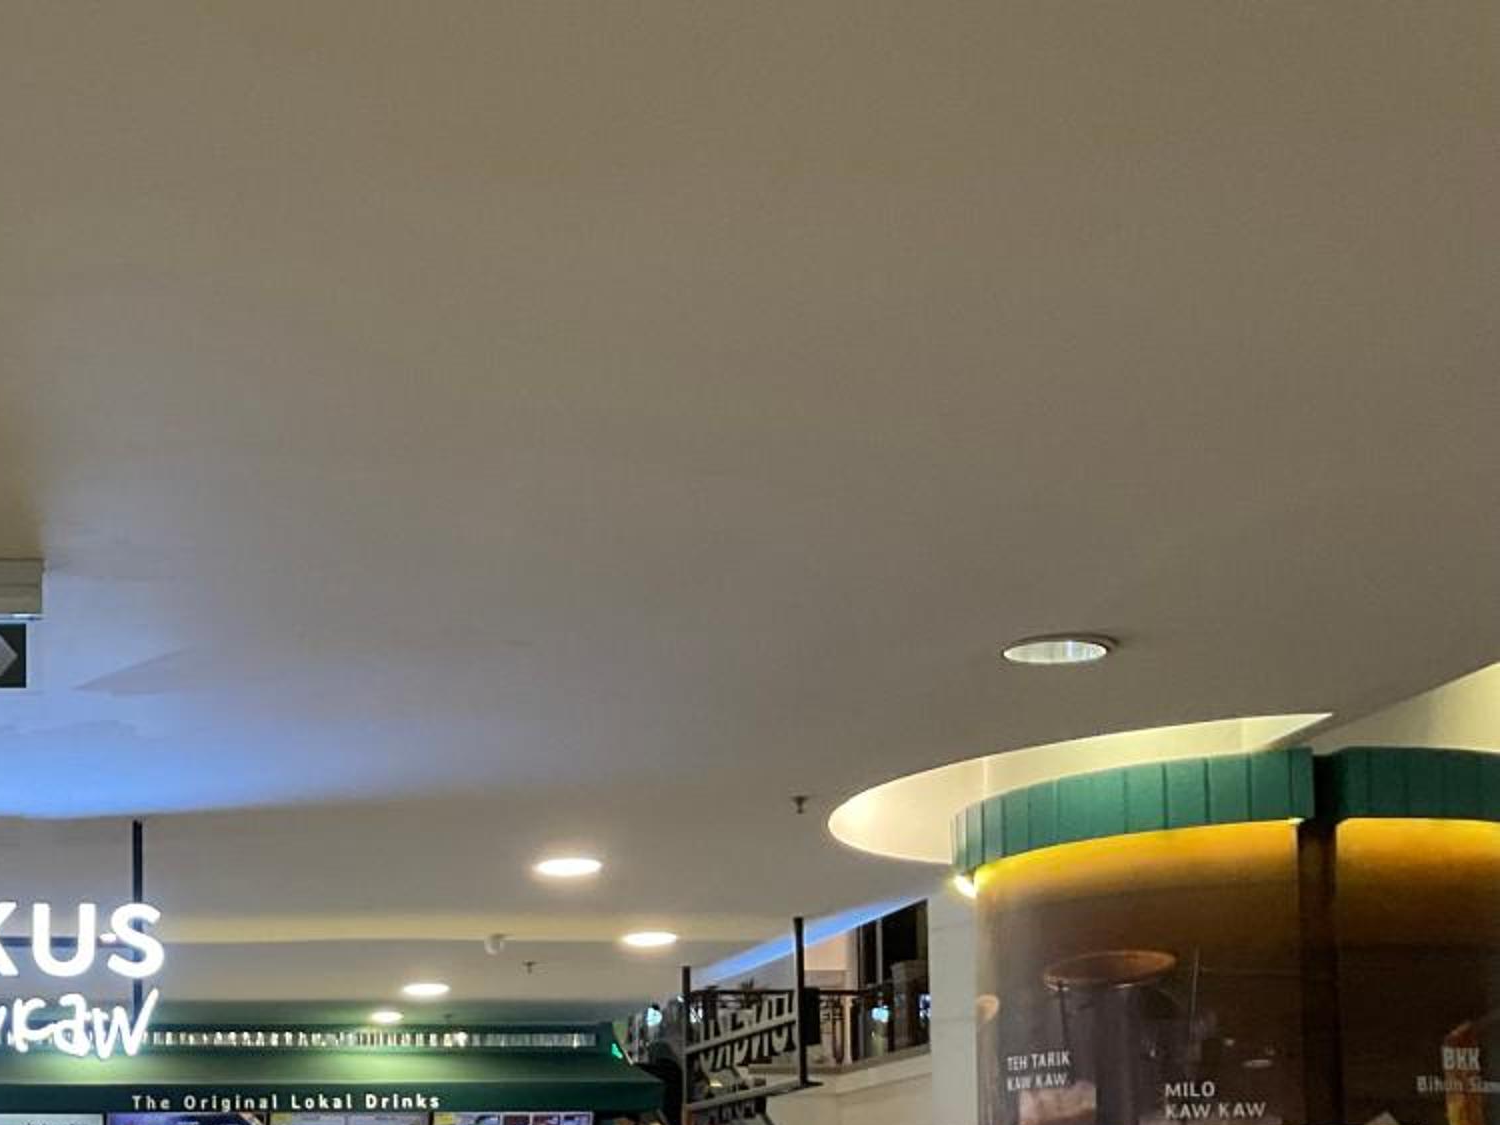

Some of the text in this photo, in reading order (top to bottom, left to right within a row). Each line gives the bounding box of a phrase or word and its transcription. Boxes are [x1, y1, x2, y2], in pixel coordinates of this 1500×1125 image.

[1031, 1051, 1071, 1069] TARIK
[1442, 1046, 1480, 1071] BKK
[1034, 1072, 1068, 1088] KAW
[1164, 1080, 1216, 1099] MILO
[132, 1093, 441, 1113] The Original Lokal Drinks
[1164, 1101, 1267, 1120] KAW KAW
